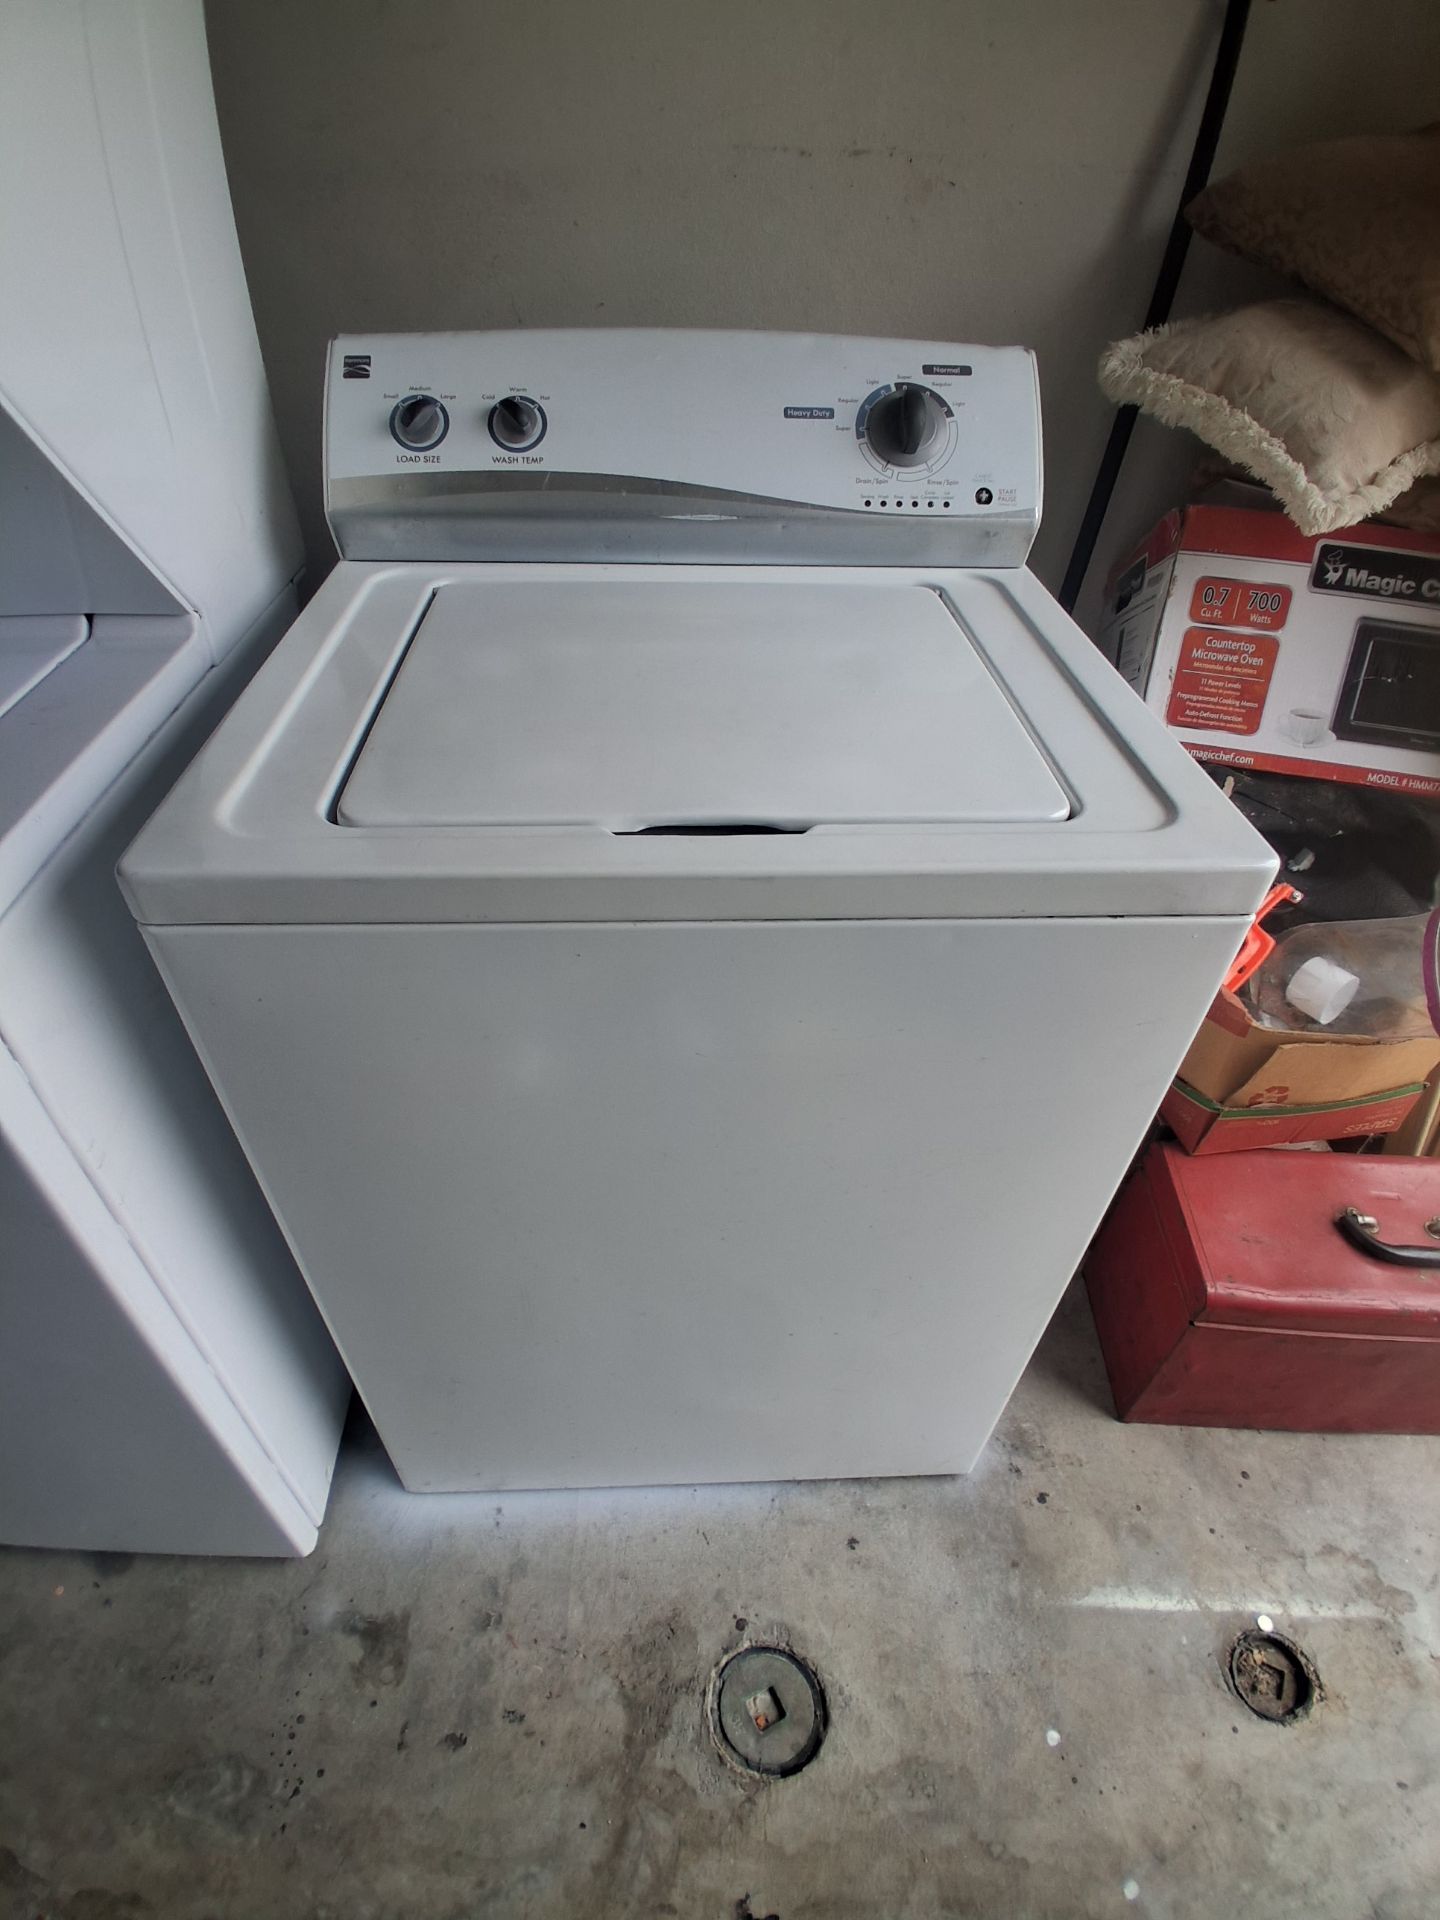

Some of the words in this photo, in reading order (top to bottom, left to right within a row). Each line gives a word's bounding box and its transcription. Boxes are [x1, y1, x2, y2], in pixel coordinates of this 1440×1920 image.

[933, 366, 961, 374] Normal
[787, 408, 811, 418] Heavy
[813, 409, 830, 418] Duty
[396, 455, 420, 463] LOAD
[423, 455, 441, 463] SIZE
[492, 456, 519, 464] WASH
[521, 456, 544, 464] TEMP
[1345, 567, 1416, 596] Magic
[1203, 586, 1232, 608] 0.7
[1247, 590, 1282, 613] 700
[1250, 613, 1272, 624] Watts
[1205, 636, 1256, 654] Countertop
[1192, 648, 1239, 663] Microwave
[1240, 654, 1264, 666] Oven
[1207, 679, 1224, 687] Power
[1225, 681, 1242, 689] Levels
[1187, 748, 1254, 765] magicchef.com
[1367, 772, 1400, 786] MODEL
